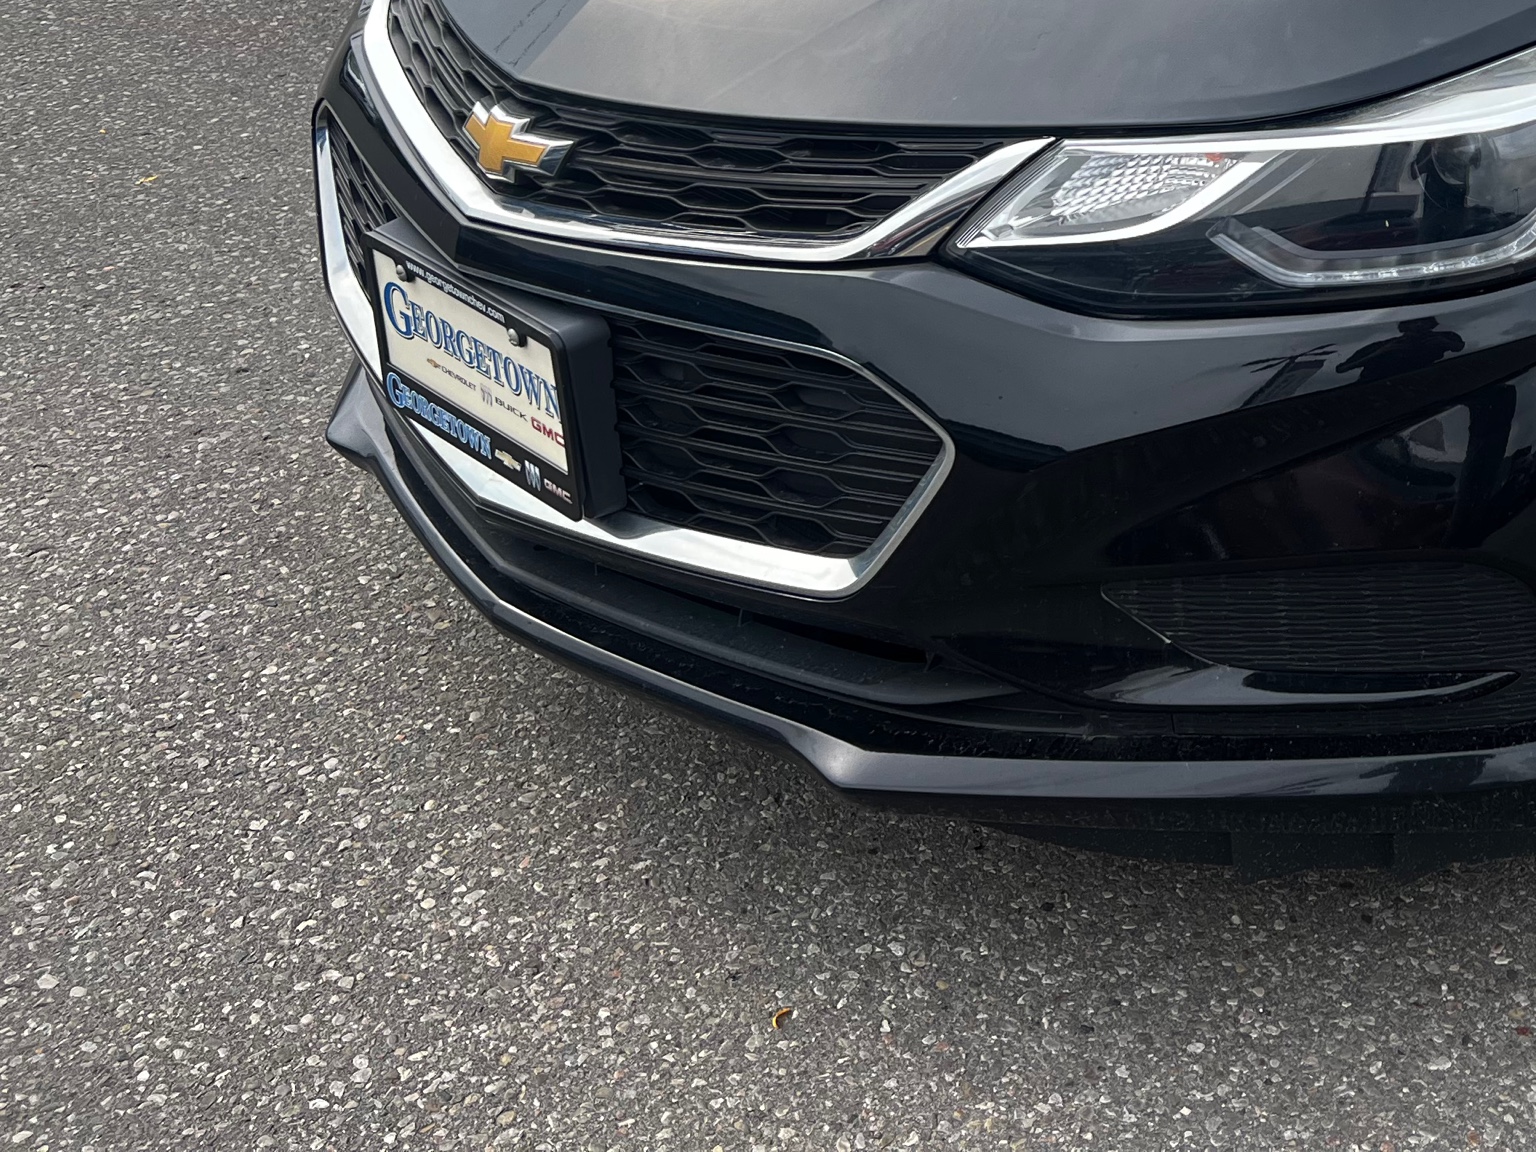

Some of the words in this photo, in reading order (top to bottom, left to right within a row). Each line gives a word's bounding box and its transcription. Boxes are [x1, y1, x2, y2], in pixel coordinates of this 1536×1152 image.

[405, 260, 506, 324] www.georgetownchev.com
[383, 281, 562, 425] GEORGETOWN
[441, 365, 477, 392] CHEVROLET
[495, 396, 528, 423] BUICK
[530, 416, 566, 448] GMC
[386, 371, 493, 461] GEORGETOWN
[543, 477, 574, 505] GMC
